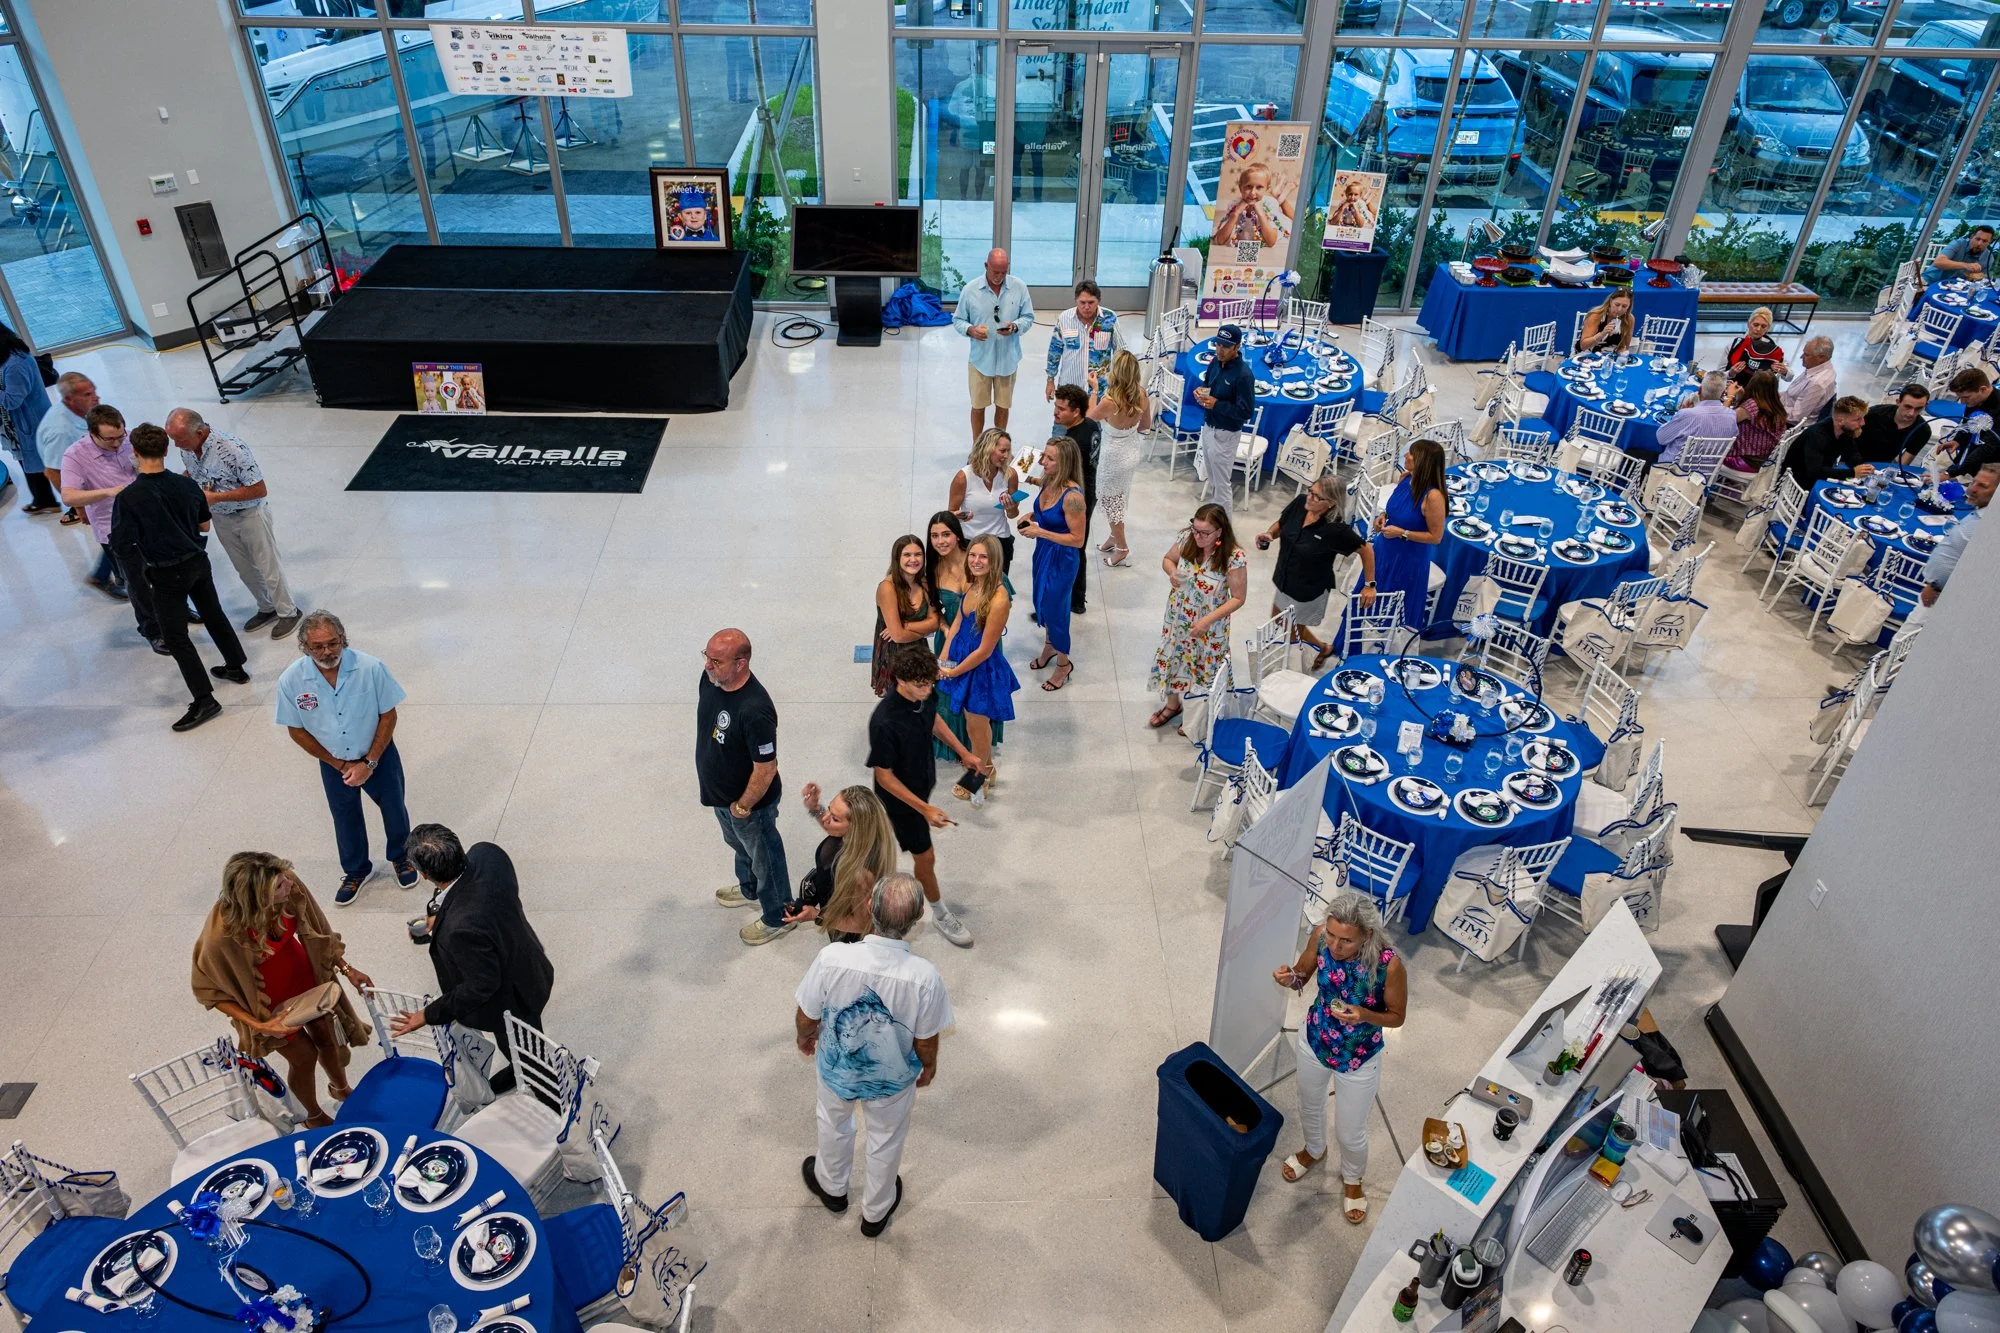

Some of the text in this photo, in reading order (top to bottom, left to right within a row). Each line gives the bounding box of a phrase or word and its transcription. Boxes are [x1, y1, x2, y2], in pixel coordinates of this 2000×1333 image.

[672, 186, 705, 194] Meet AJ
[560, 459, 622, 467] SALES
[1286, 454, 1314, 470] HMY
[1649, 627, 1683, 637] HMY
[1450, 916, 1490, 945] HMY
[662, 1256, 688, 1307] HMY
